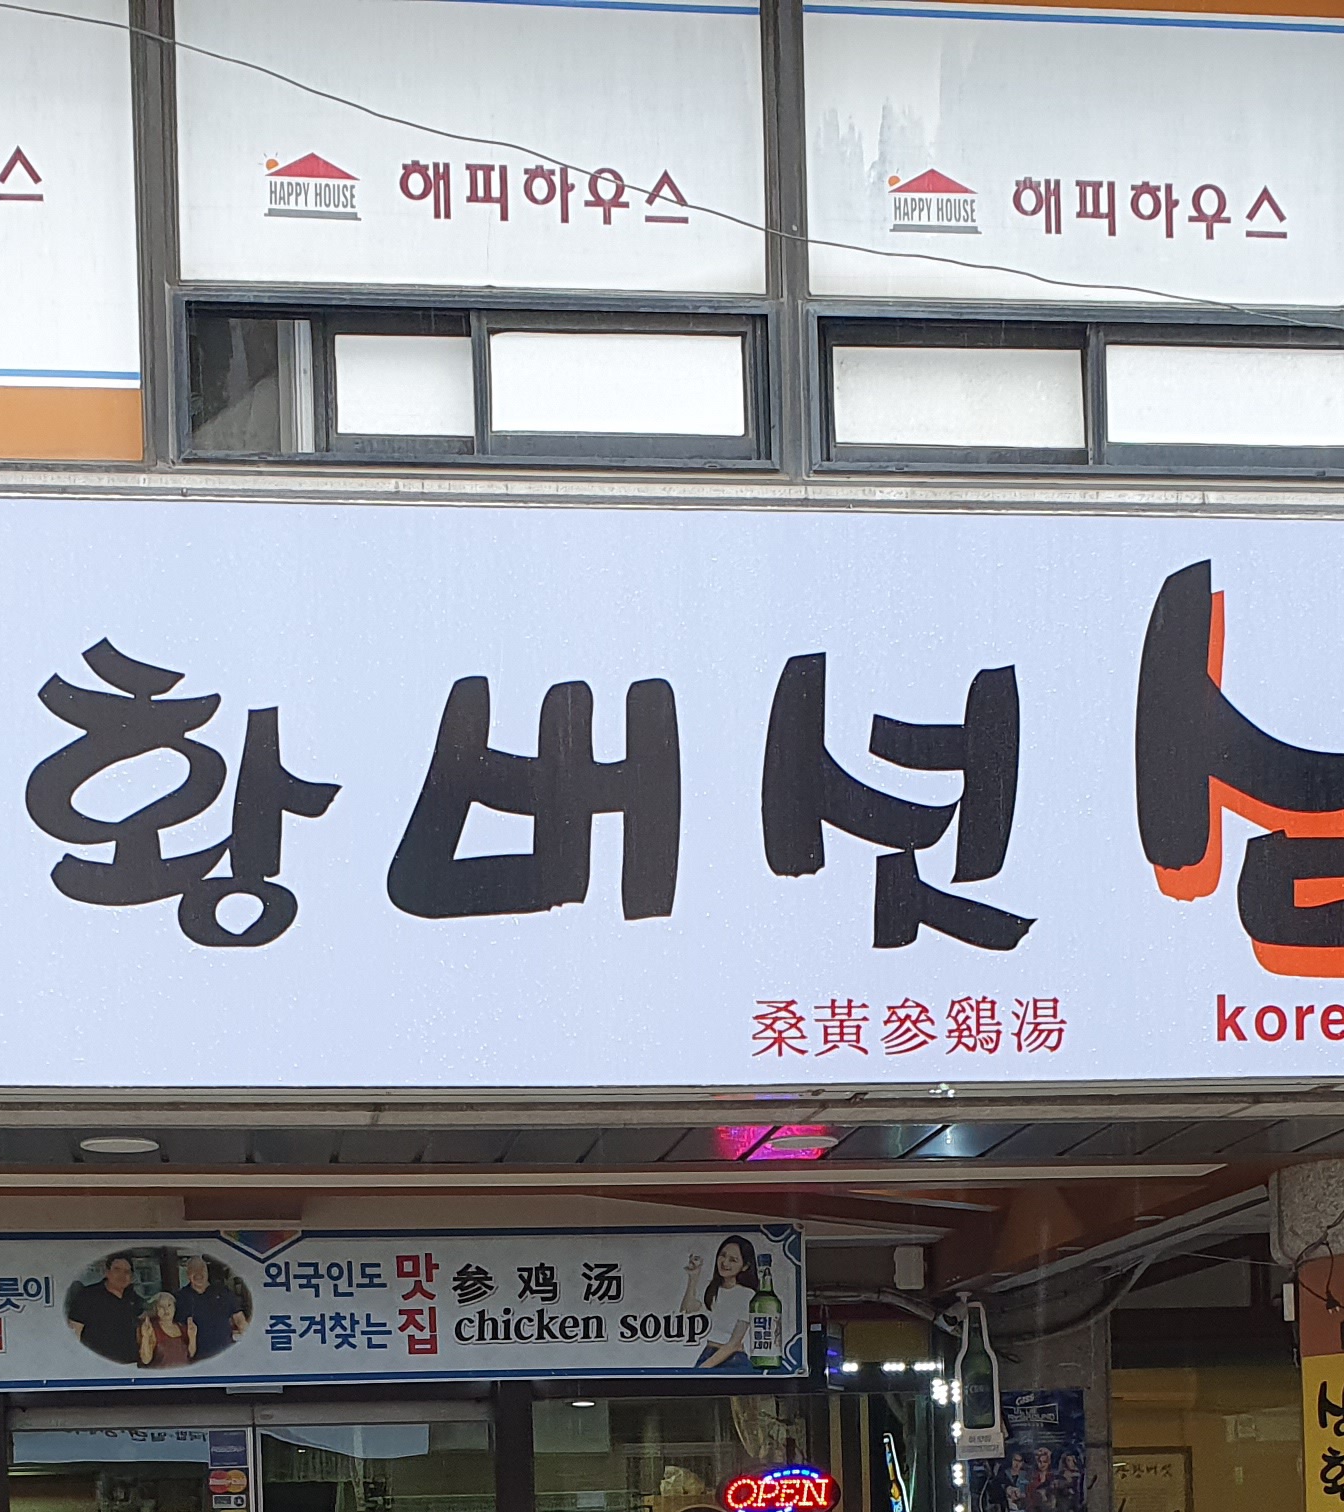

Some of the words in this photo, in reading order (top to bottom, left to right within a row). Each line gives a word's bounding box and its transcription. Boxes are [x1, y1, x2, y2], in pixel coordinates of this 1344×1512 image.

[269, 180, 309, 208] HAPPY
[314, 182, 357, 210] HOUSE
[399, 160, 689, 225] 해피하우스
[893, 196, 932, 222] HAPPY
[936, 198, 977, 224] HOUSE
[1012, 177, 1288, 240] 해피하우스
[263, 1261, 388, 1298] 외국인도
[452, 1260, 623, 1306] 参鸡汤
[264, 1312, 393, 1352] 즐겨찾는
[454, 1306, 607, 1346] chicken
[619, 1310, 710, 1348] soup
[726, 1477, 829, 1509] OPEN
